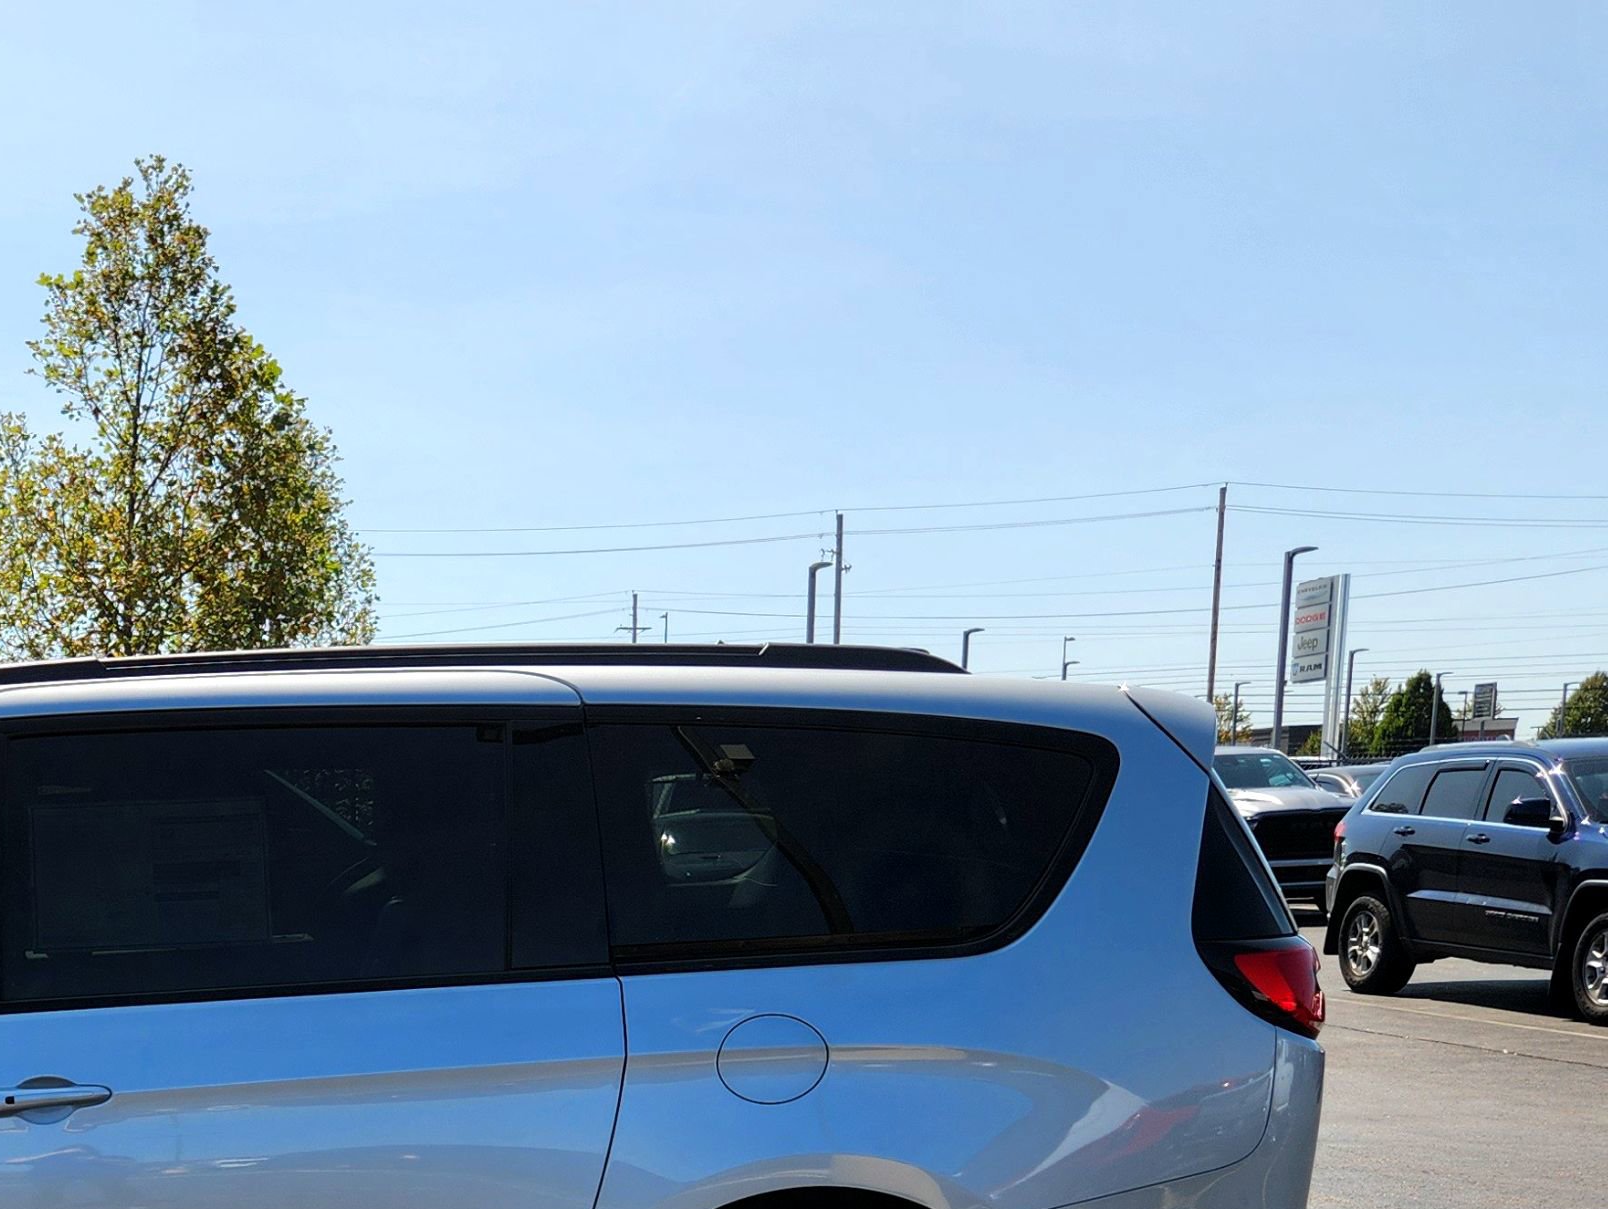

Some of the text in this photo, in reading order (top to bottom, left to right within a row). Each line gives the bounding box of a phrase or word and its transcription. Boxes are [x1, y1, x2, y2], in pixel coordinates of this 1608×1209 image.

[1295, 612, 1326, 625] DODGE
[1297, 636, 1318, 651] Jeep
[1299, 663, 1323, 673] RAM
